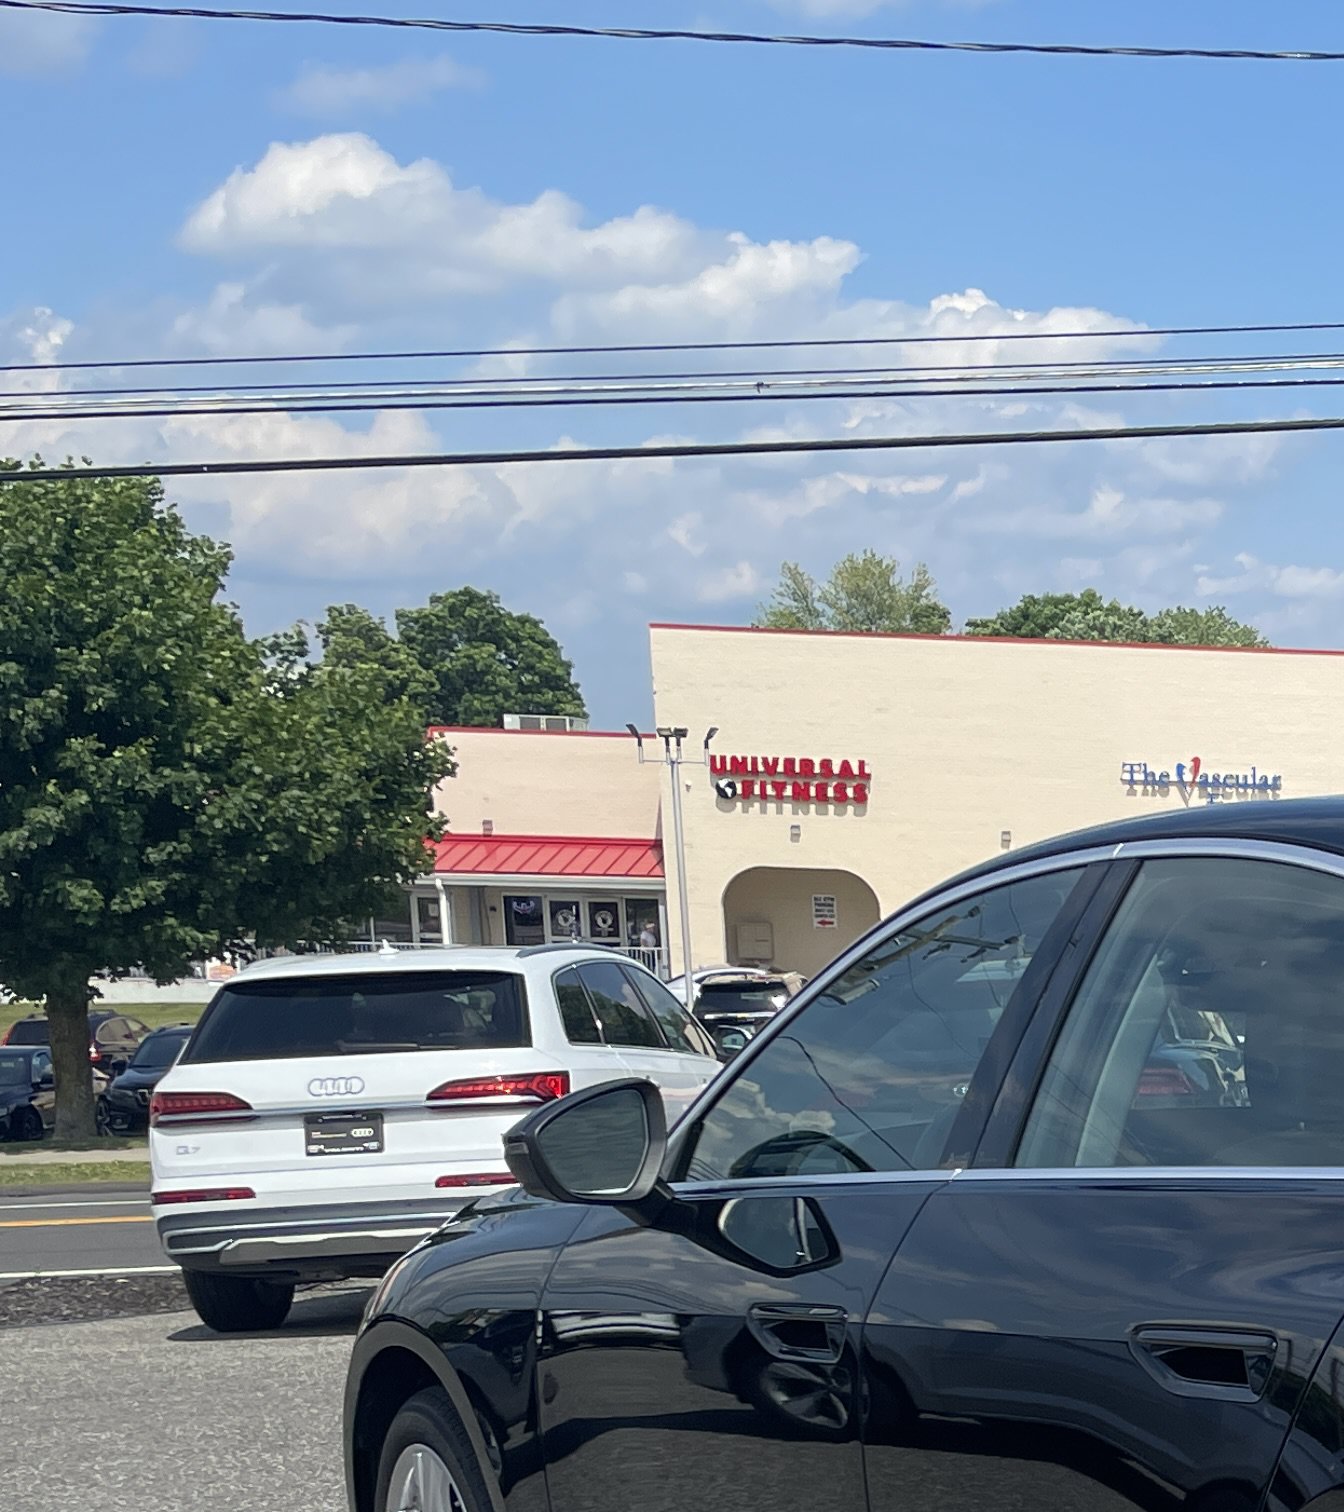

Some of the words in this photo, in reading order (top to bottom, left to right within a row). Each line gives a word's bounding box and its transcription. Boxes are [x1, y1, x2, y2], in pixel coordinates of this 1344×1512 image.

[710, 754, 871, 779] UNIVERSAL
[1121, 762, 1169, 787] The
[1176, 757, 1282, 791] Vascular
[741, 779, 868, 804] FITNESS
